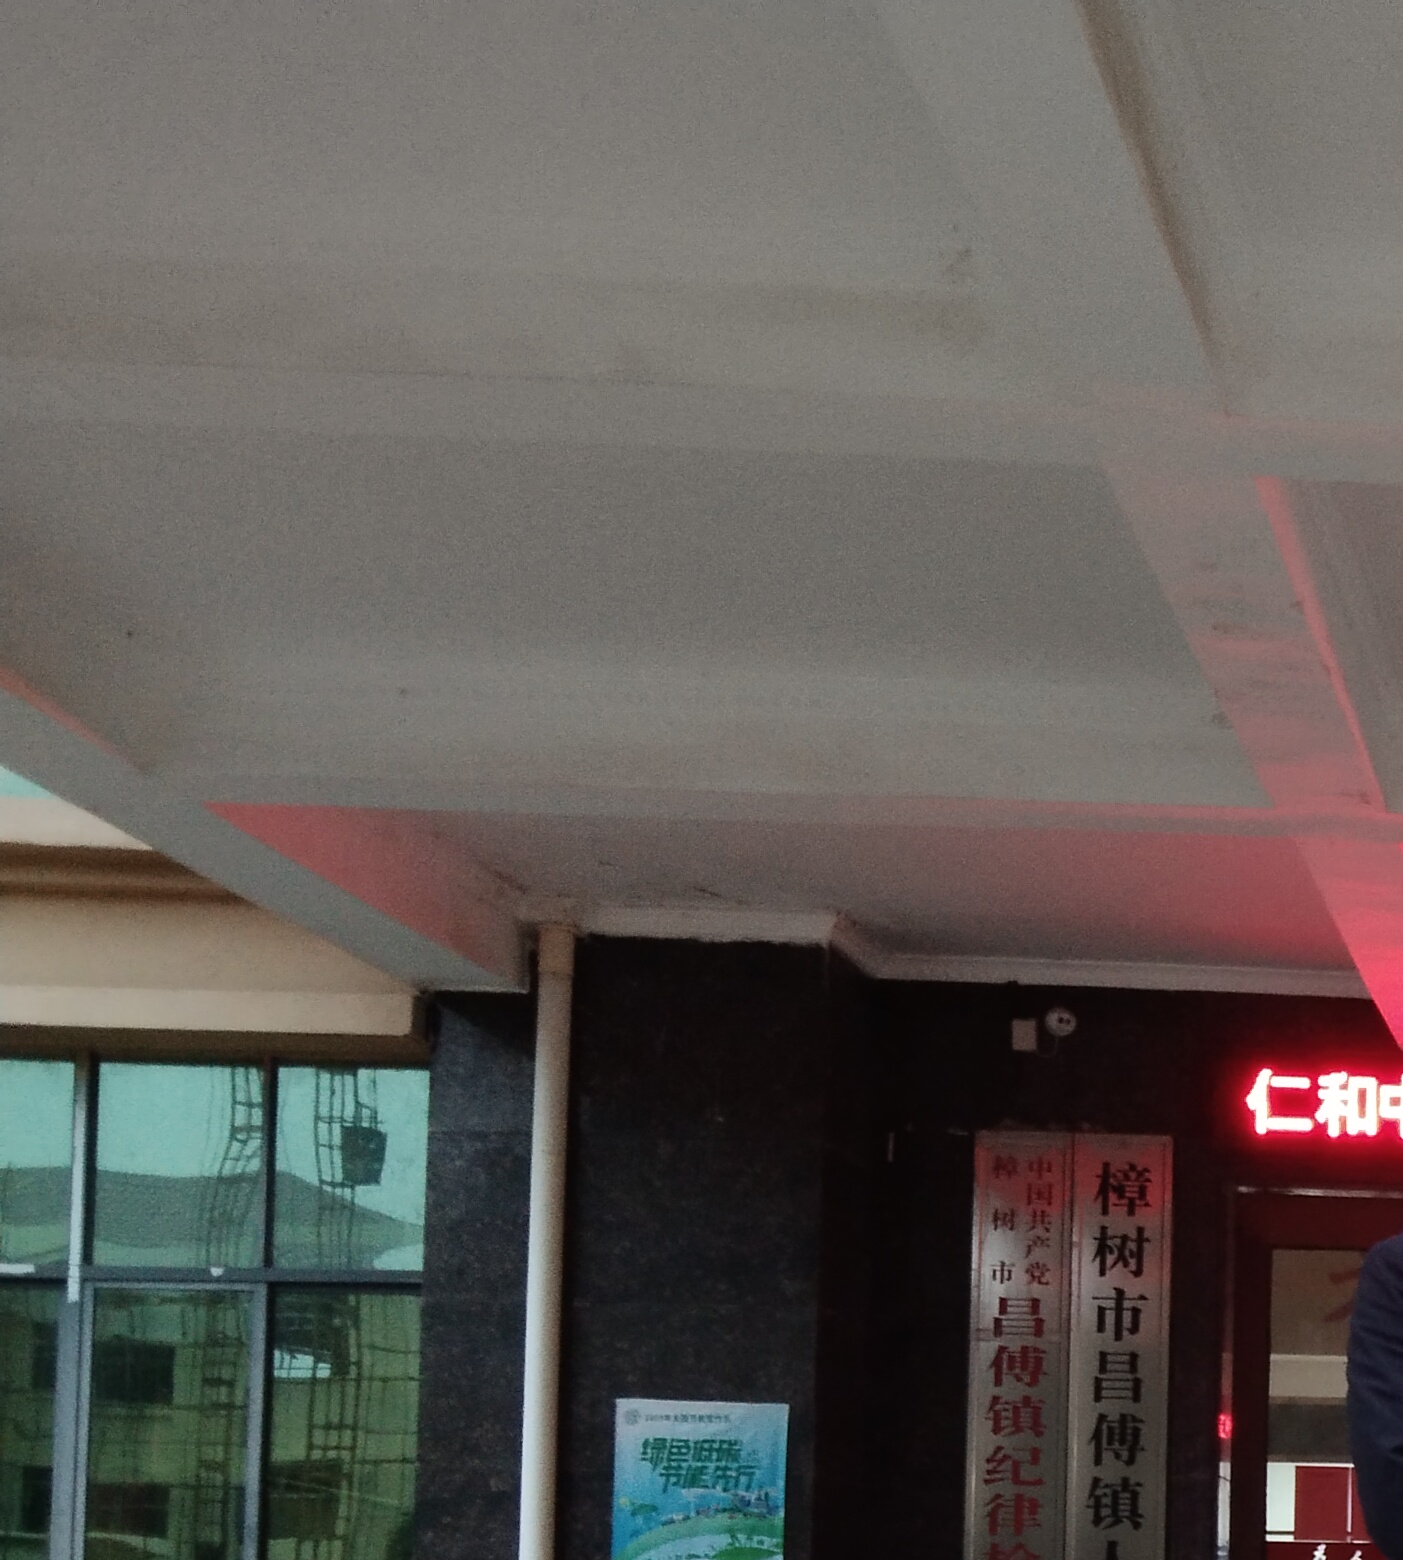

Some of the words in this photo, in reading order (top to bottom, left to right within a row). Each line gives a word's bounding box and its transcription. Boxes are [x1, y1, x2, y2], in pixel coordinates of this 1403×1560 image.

[1023, 1156, 1052, 1287] 中国共产党
